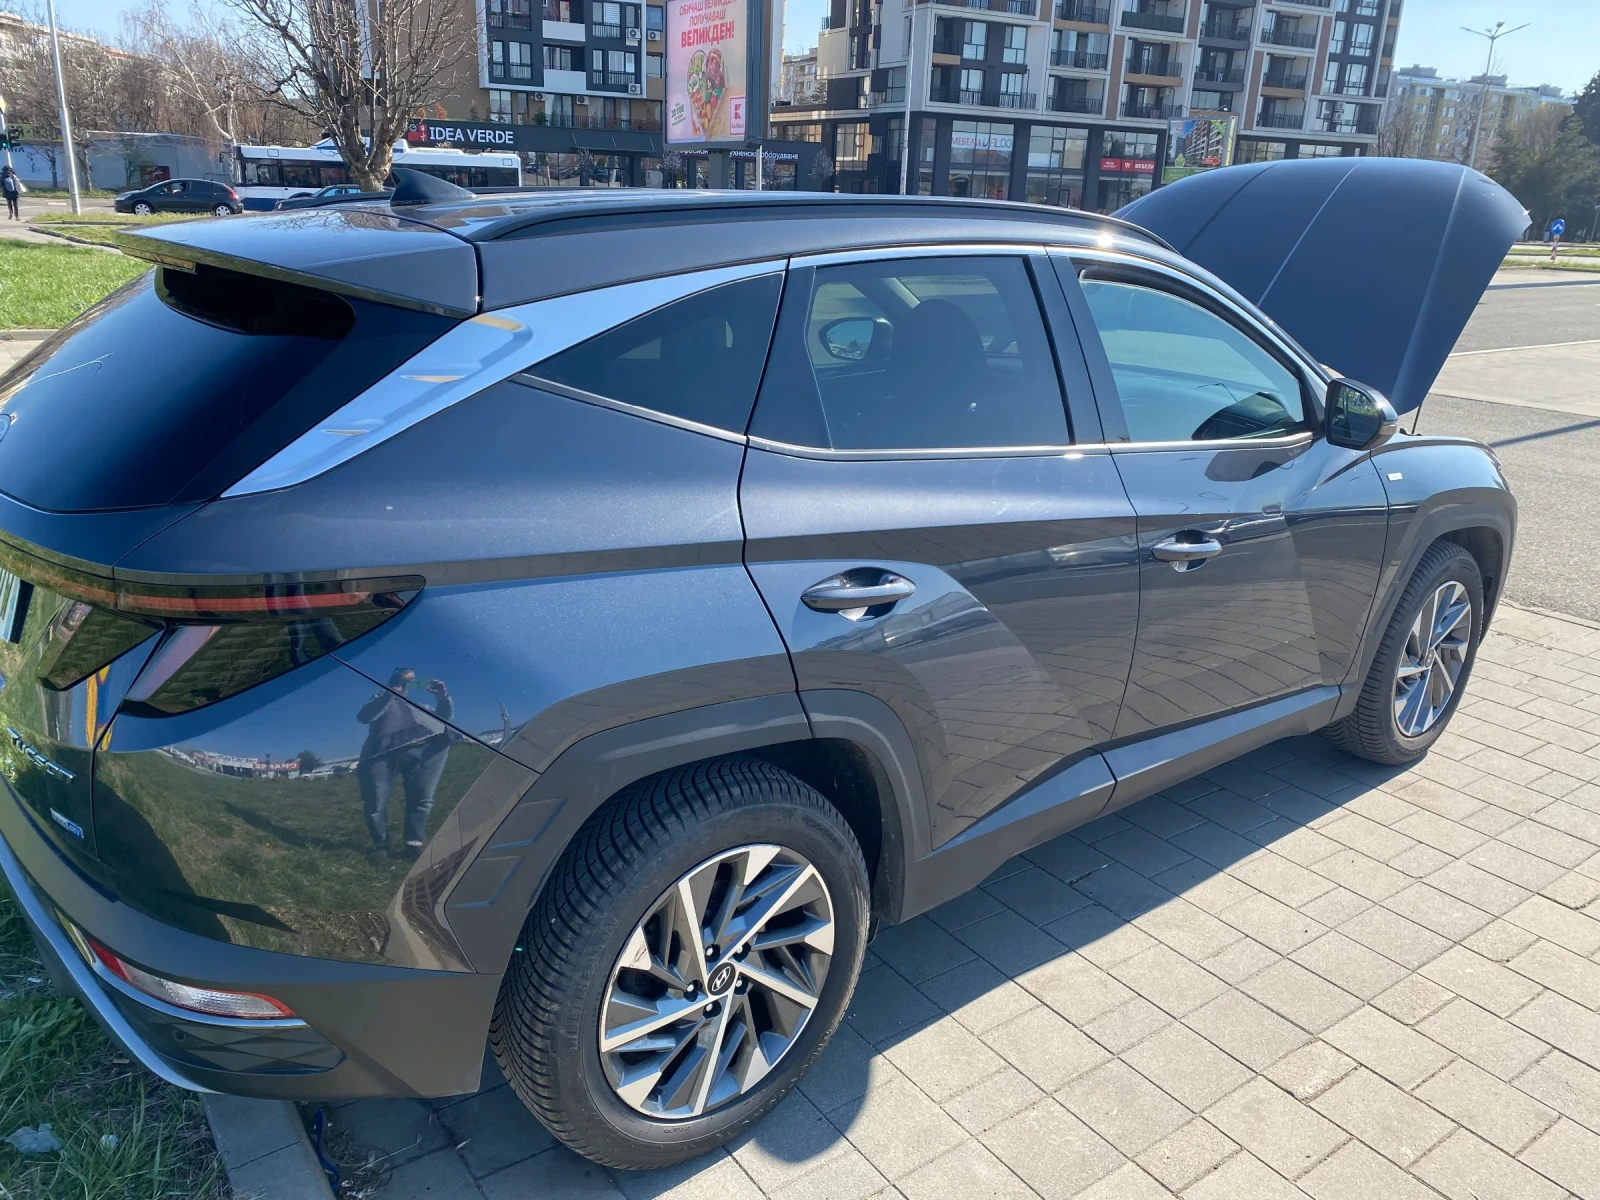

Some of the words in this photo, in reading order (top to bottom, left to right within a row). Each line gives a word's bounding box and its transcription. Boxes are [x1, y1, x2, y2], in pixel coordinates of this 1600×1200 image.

[679, 1, 704, 16] ОБИЧАШ
[689, 9, 726, 27] ПОЛУЧАВАШ
[681, 20, 735, 48] ВЕЛИКДЕН!
[429, 126, 465, 142] IDEA
[467, 128, 514, 144] VERDE
[952, 136, 981, 147] МЕБЕЛИ
